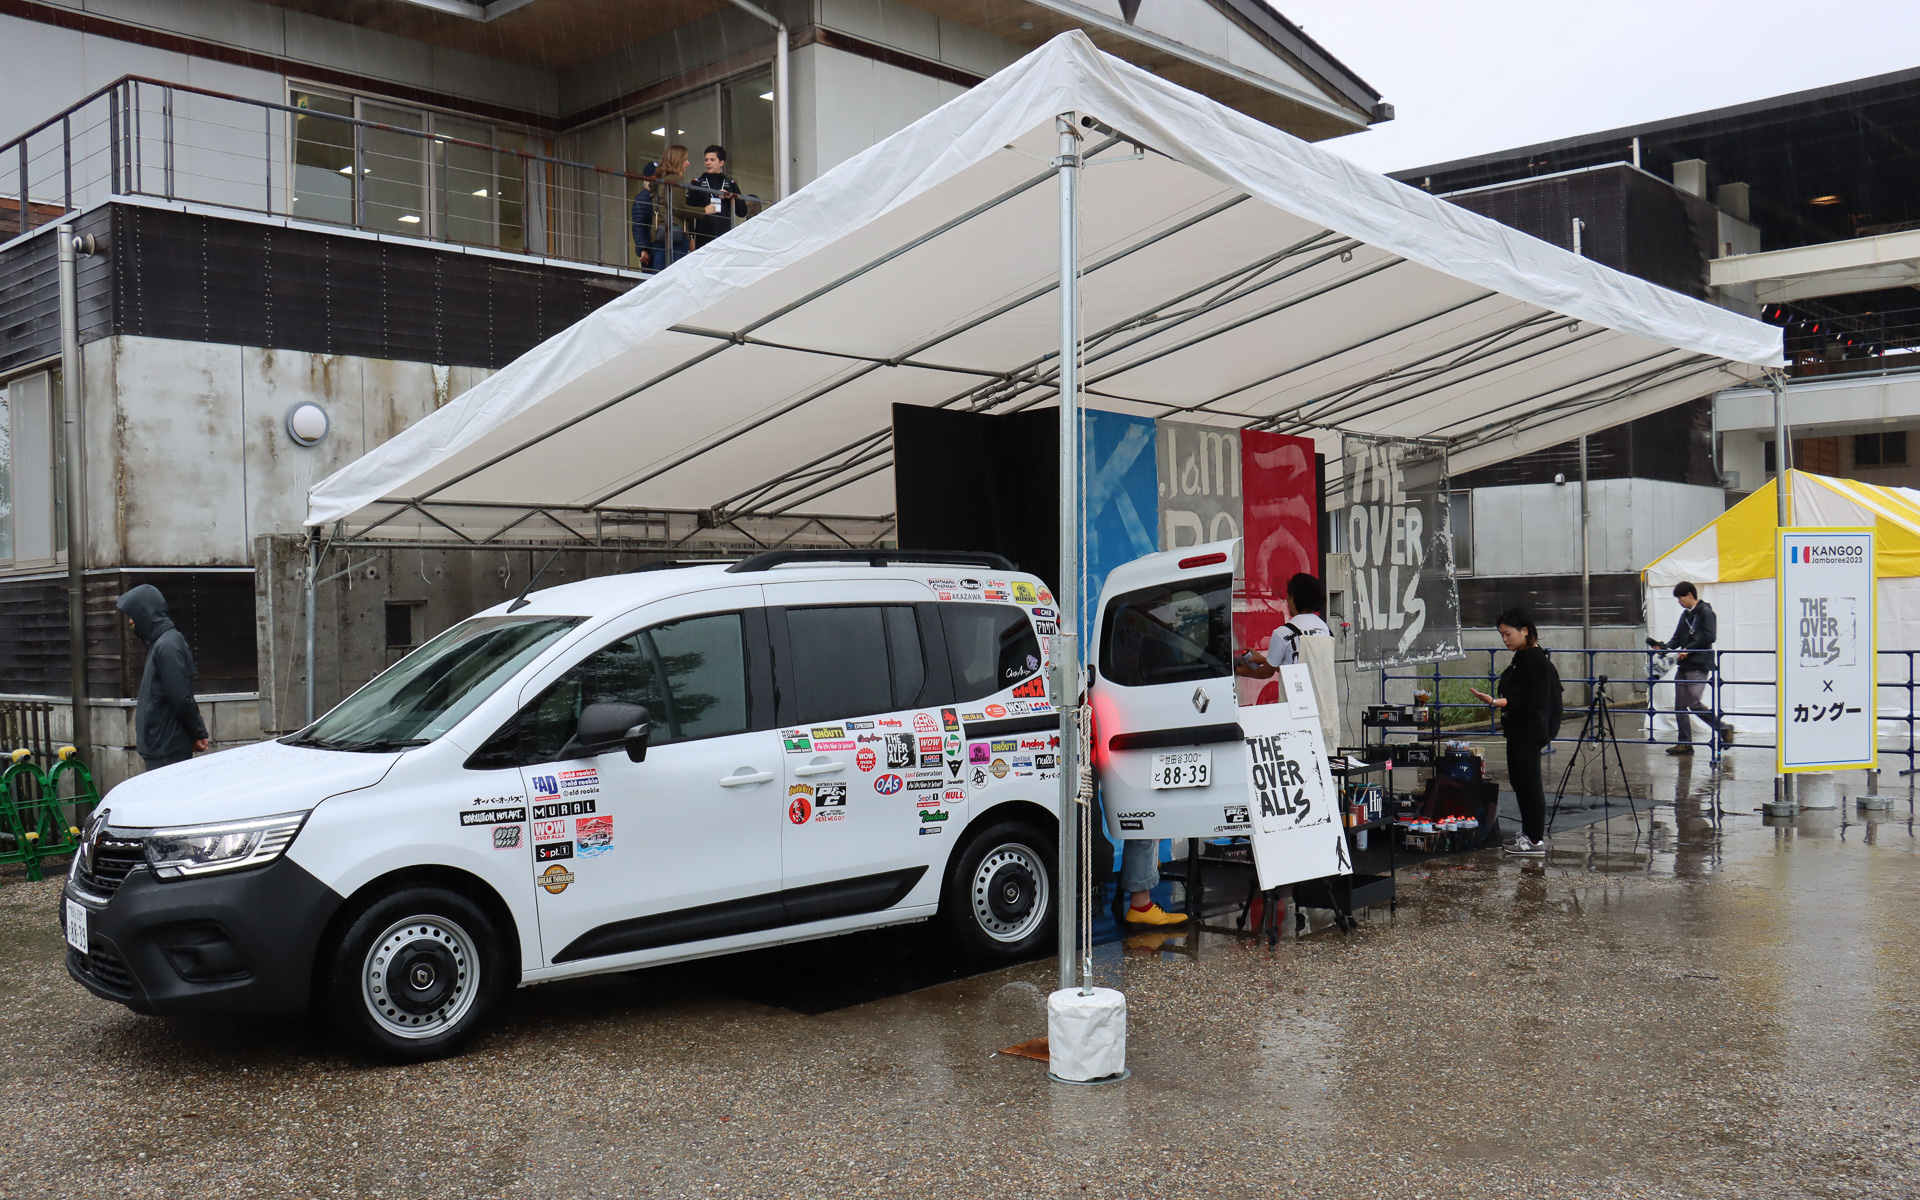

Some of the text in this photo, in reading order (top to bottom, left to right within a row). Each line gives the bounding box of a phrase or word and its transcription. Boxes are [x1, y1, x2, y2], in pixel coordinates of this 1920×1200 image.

[1349, 446, 1406, 505] THE
[1350, 504, 1423, 568] OVER
[1812, 546, 1863, 556] KANGOO
[1356, 565, 1426, 654] ALLS
[1800, 597, 1828, 618] THE
[1800, 617, 1839, 638] OVER
[1800, 637, 1841, 666] ALLS
[1006, 701, 1029, 712] WOW
[1794, 702, 1862, 723] カングー
[885, 734, 902, 744] THE
[887, 743, 909, 754] OVER
[920, 738, 940, 747] WOW
[1021, 739, 1045, 750] Analog
[1245, 736, 1285, 763] THE
[888, 752, 909, 767] ALLS
[578, 777, 599, 785] rookie
[876, 774, 900, 793] OAS
[1164, 764, 1207, 785] 88-39
[1253, 760, 1304, 790] OVER
[531, 775, 559, 795] FAD
[580, 787, 600, 795] rookie
[945, 791, 964, 799] NULL
[534, 801, 593, 818] MURAL
[1260, 787, 1311, 824] ALLS
[534, 820, 565, 836] WOW
